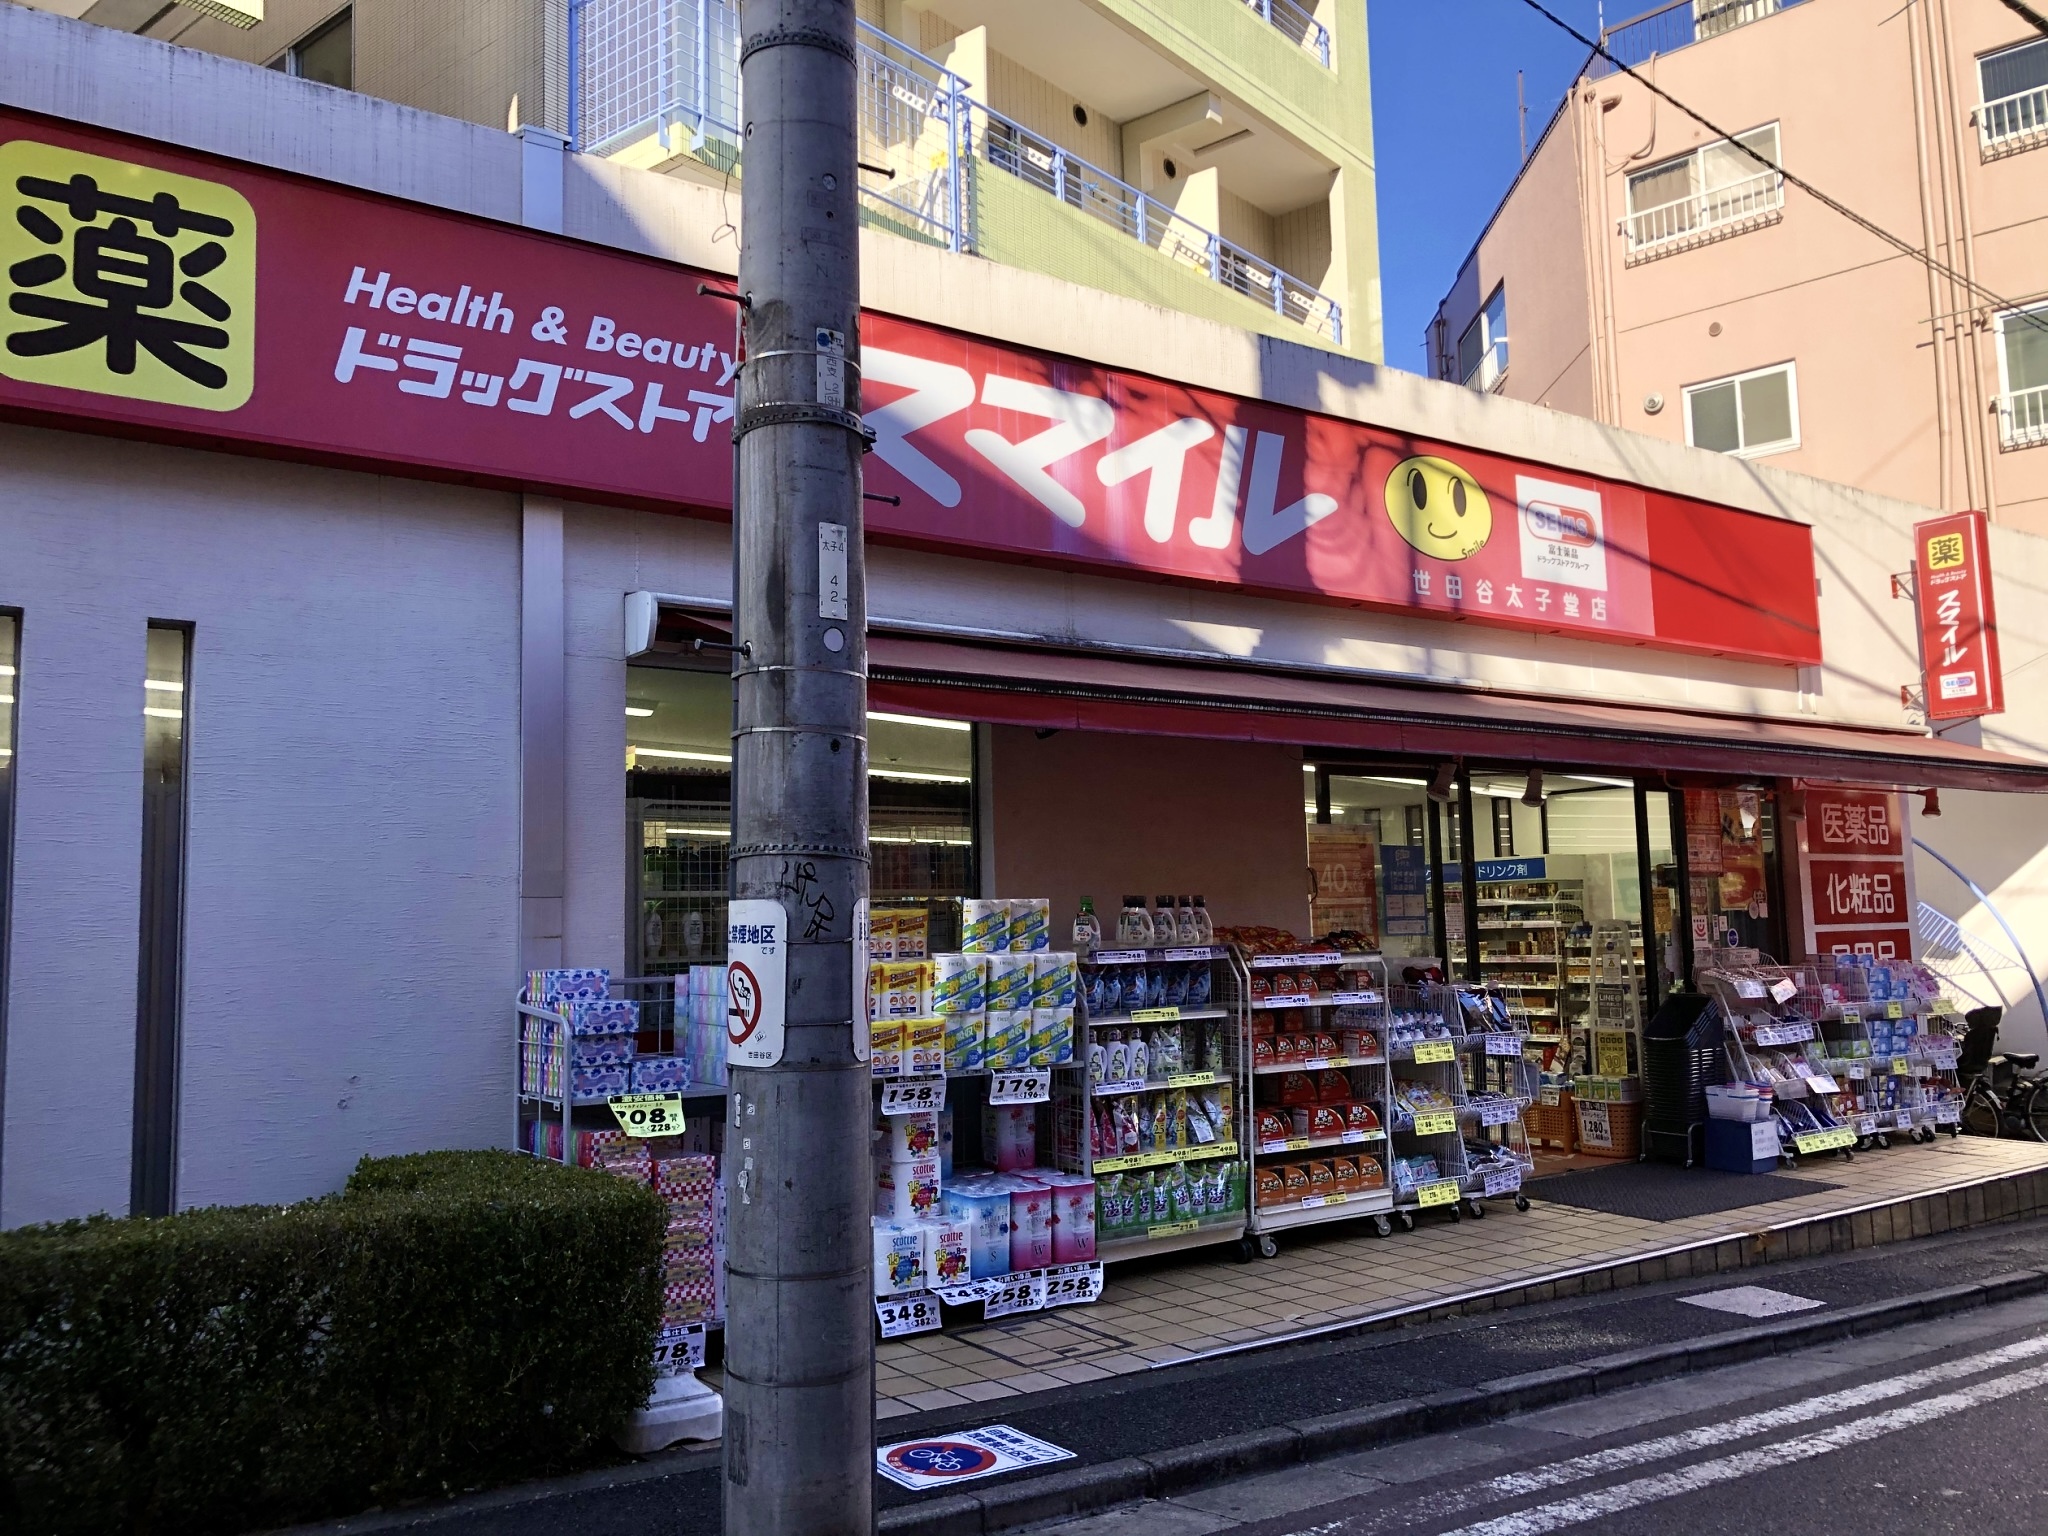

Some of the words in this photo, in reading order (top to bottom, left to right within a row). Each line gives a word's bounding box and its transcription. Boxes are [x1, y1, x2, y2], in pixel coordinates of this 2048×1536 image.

[6, 174, 235, 390] 薬
[344, 266, 515, 334] Health
[531, 306, 569, 345] &
[585, 316, 738, 387] Beauty
[335, 326, 737, 443] ドラッグストア
[861, 346, 1338, 556] スマイル
[1535, 511, 1588, 538] SEIMS
[1461, 539, 1485, 558] Smile
[1548, 544, 1579, 560] 富士薬品
[1931, 537, 1961, 566] 薬
[1537, 555, 1590, 571] ドラッグストアグループ
[1412, 569, 1607, 621] 世田谷太子堂店
[1937, 589, 1967, 667] スマイル
[1821, 803, 1890, 845] 医薬品
[1320, 863, 1347, 893] 40
[1477, 863, 1528, 878] ドリンク剤
[1827, 873, 1895, 915] 化粧品
[761, 947, 776, 955] です
[748, 1051, 773, 1060] 世田谷区
[888, 1087, 933, 1103] 158
[997, 1078, 1038, 1093] 179
[621, 1094, 666, 1102] 激安価格
[912, 1164, 936, 1176] scottie
[892, 1235, 918, 1247] scottie
[940, 1231, 964, 1243] scottie
[987, 1285, 1030, 1306] 258
[1047, 1276, 1091, 1295] 258
[882, 1303, 927, 1325] 348
